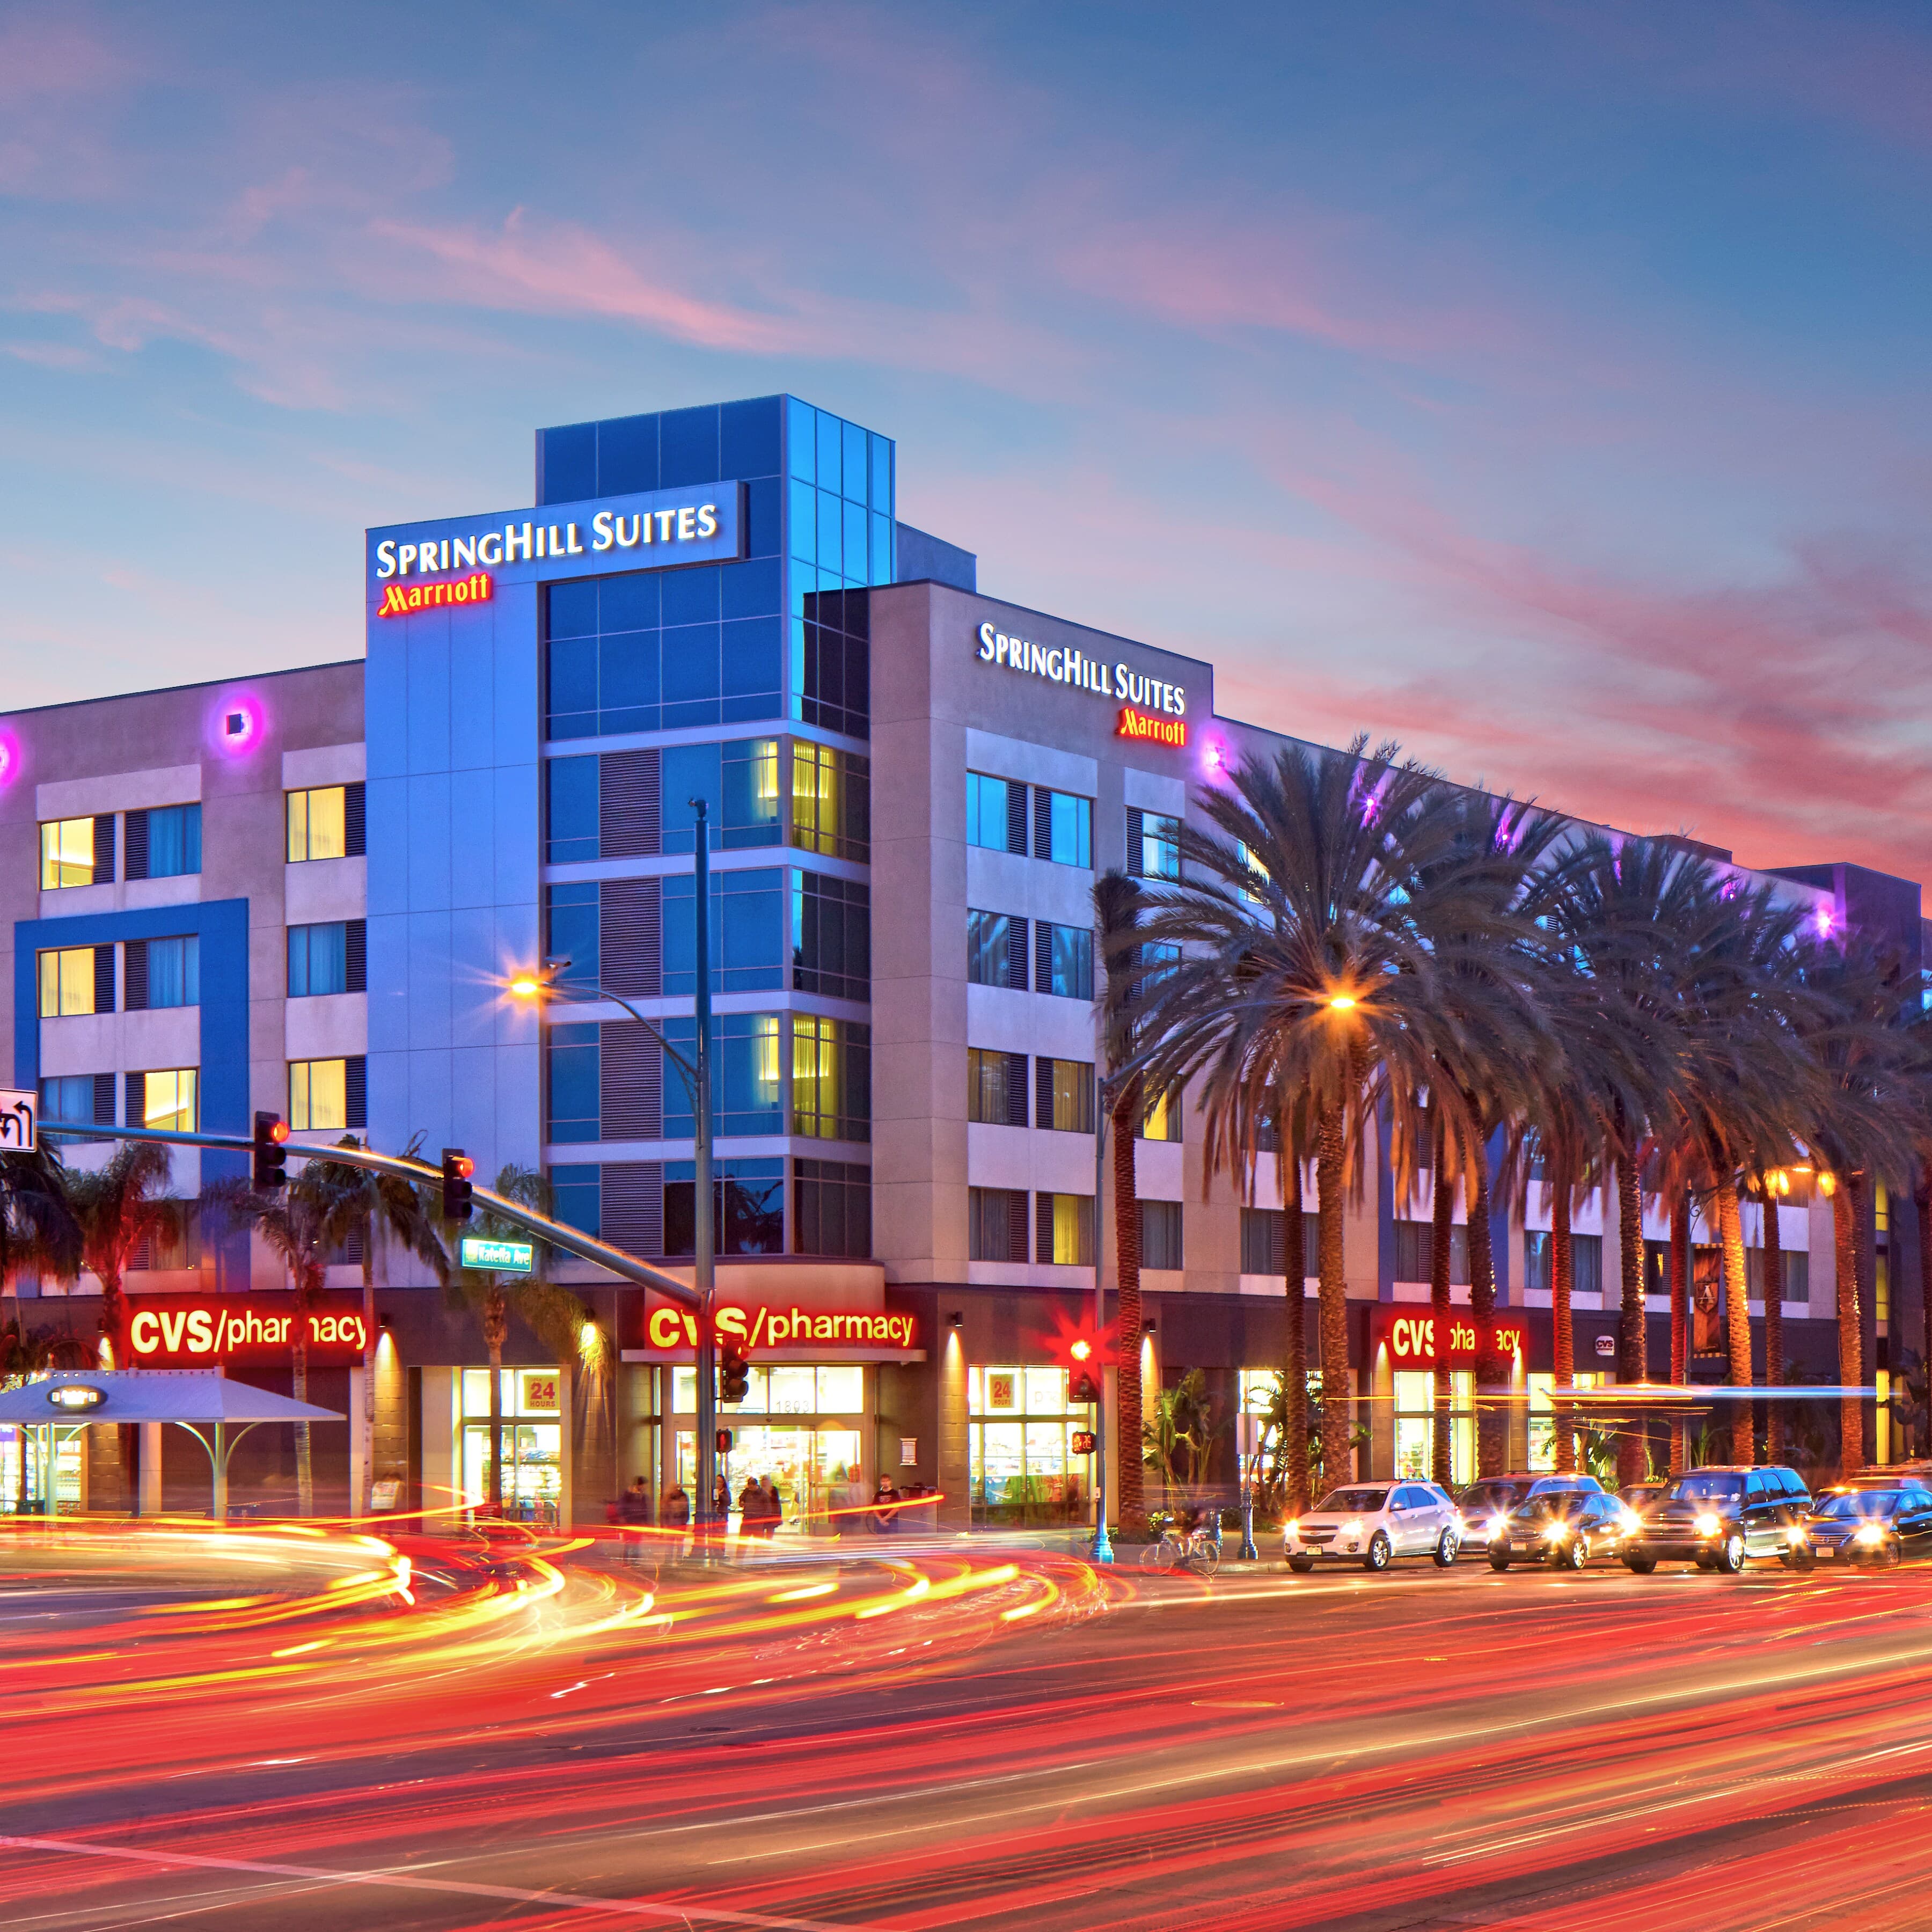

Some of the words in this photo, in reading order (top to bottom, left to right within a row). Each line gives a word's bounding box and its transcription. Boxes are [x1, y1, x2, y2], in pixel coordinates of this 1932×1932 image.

[591, 503, 717, 551] SUITES
[377, 573, 488, 617] Marriott
[1115, 663, 1185, 715] SUITES
[1121, 708, 1184, 746] Marriott
[479, 1246, 510, 1263] Katella
[514, 1249, 530, 1265] Ave
[530, 1382, 555, 1399] 24
[994, 1381, 1011, 1397] 24
